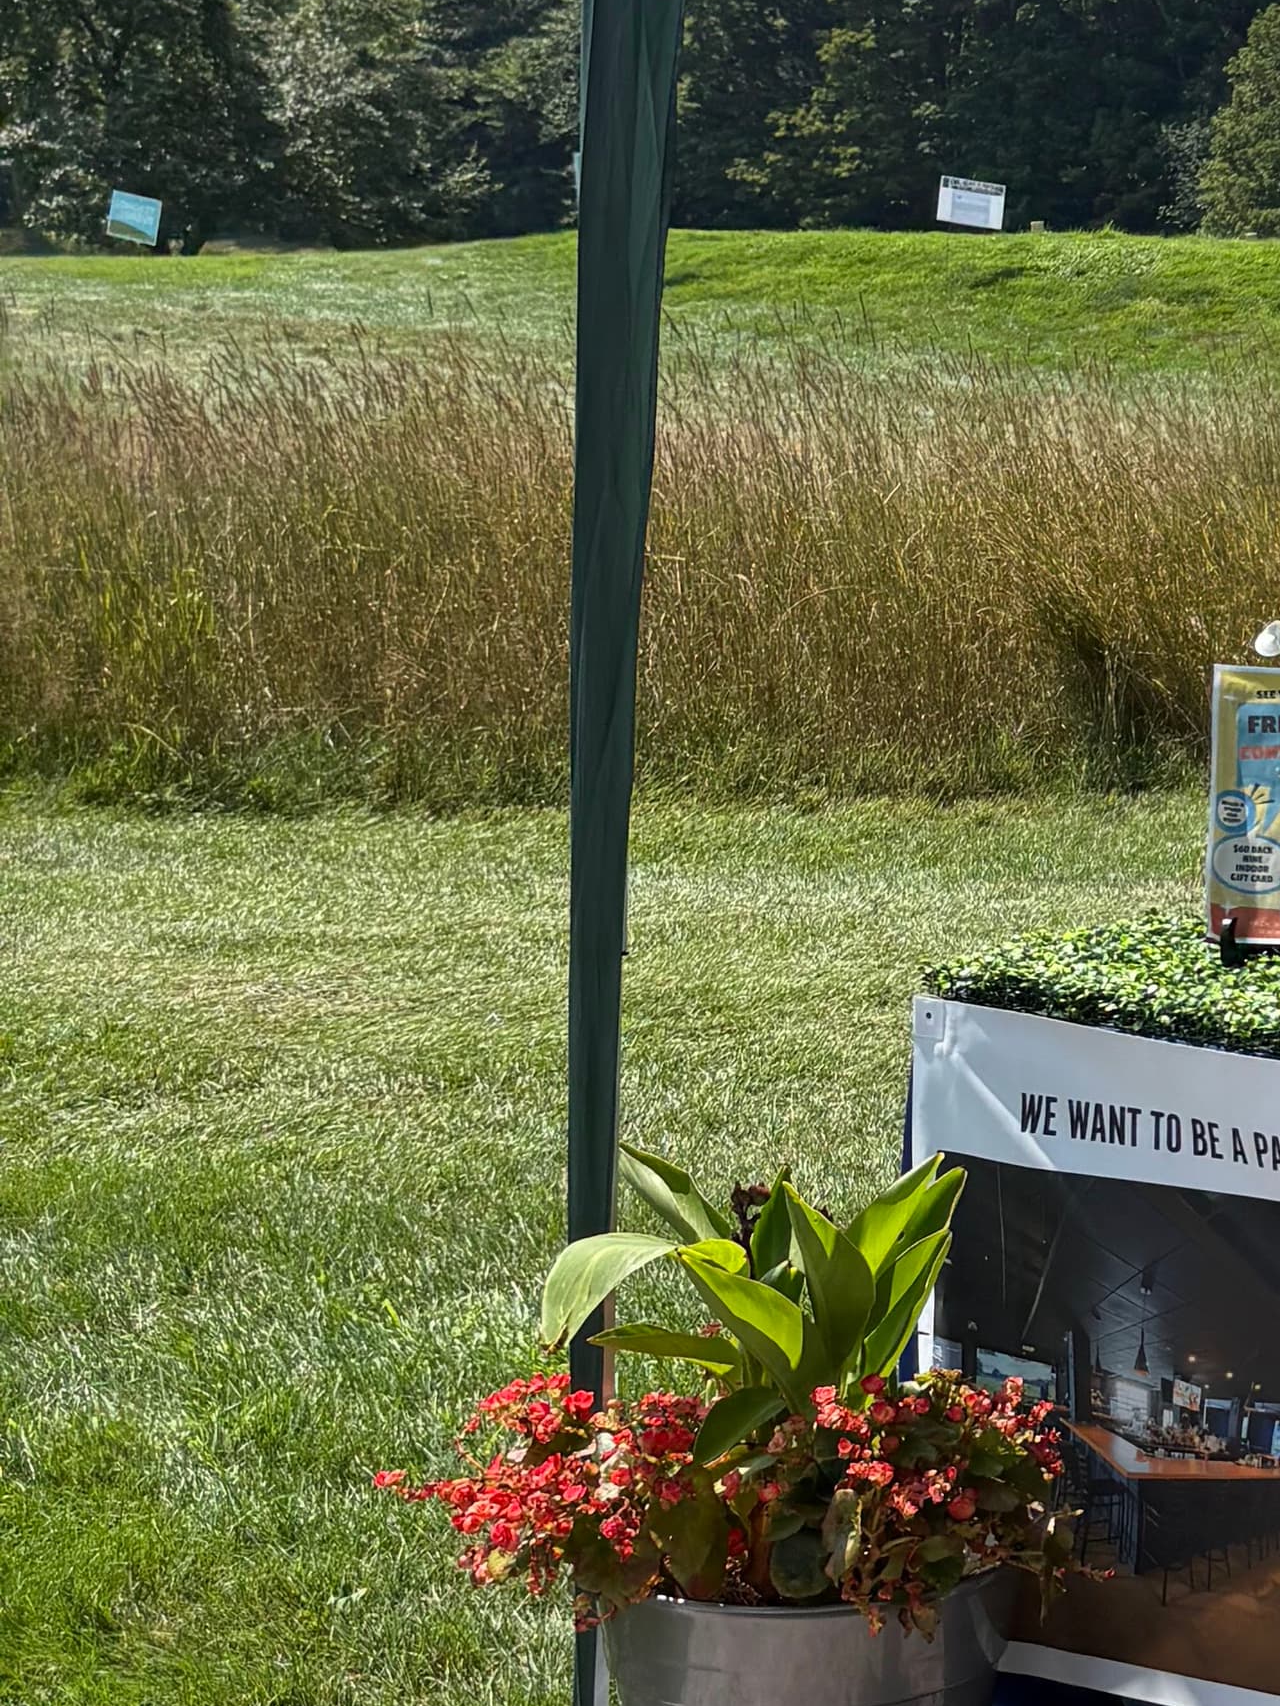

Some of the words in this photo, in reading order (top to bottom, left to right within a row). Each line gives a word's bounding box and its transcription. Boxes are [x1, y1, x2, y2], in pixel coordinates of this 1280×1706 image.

[1019, 1092, 1058, 1137] WE
[1068, 1099, 1142, 1148] WANT
[1150, 1110, 1183, 1154] TO
[1191, 1118, 1225, 1160] BE
[1231, 1127, 1250, 1166] A
